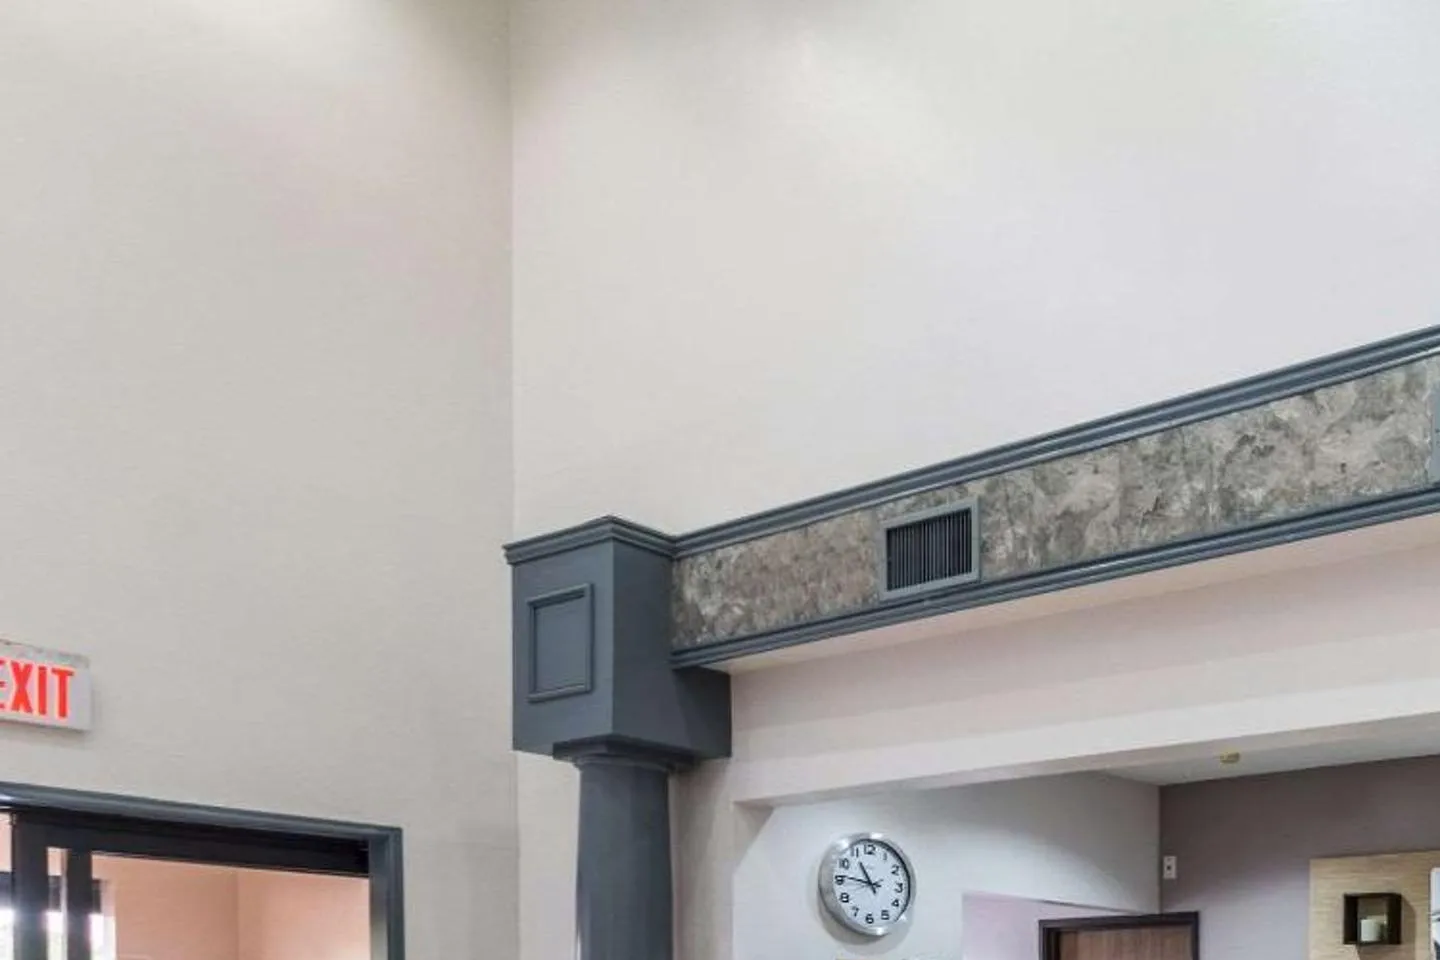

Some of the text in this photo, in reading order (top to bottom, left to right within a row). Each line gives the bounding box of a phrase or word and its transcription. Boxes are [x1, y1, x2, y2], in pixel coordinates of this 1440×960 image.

[863, 844, 876, 855] 12
[891, 863, 900, 876] 2
[894, 882, 903, 893] 3
[840, 892, 850, 903] 8
[891, 898, 899, 907] 4
[852, 906, 859, 917] 7
[881, 909, 890, 920] 5
[865, 913, 875, 924] 6
